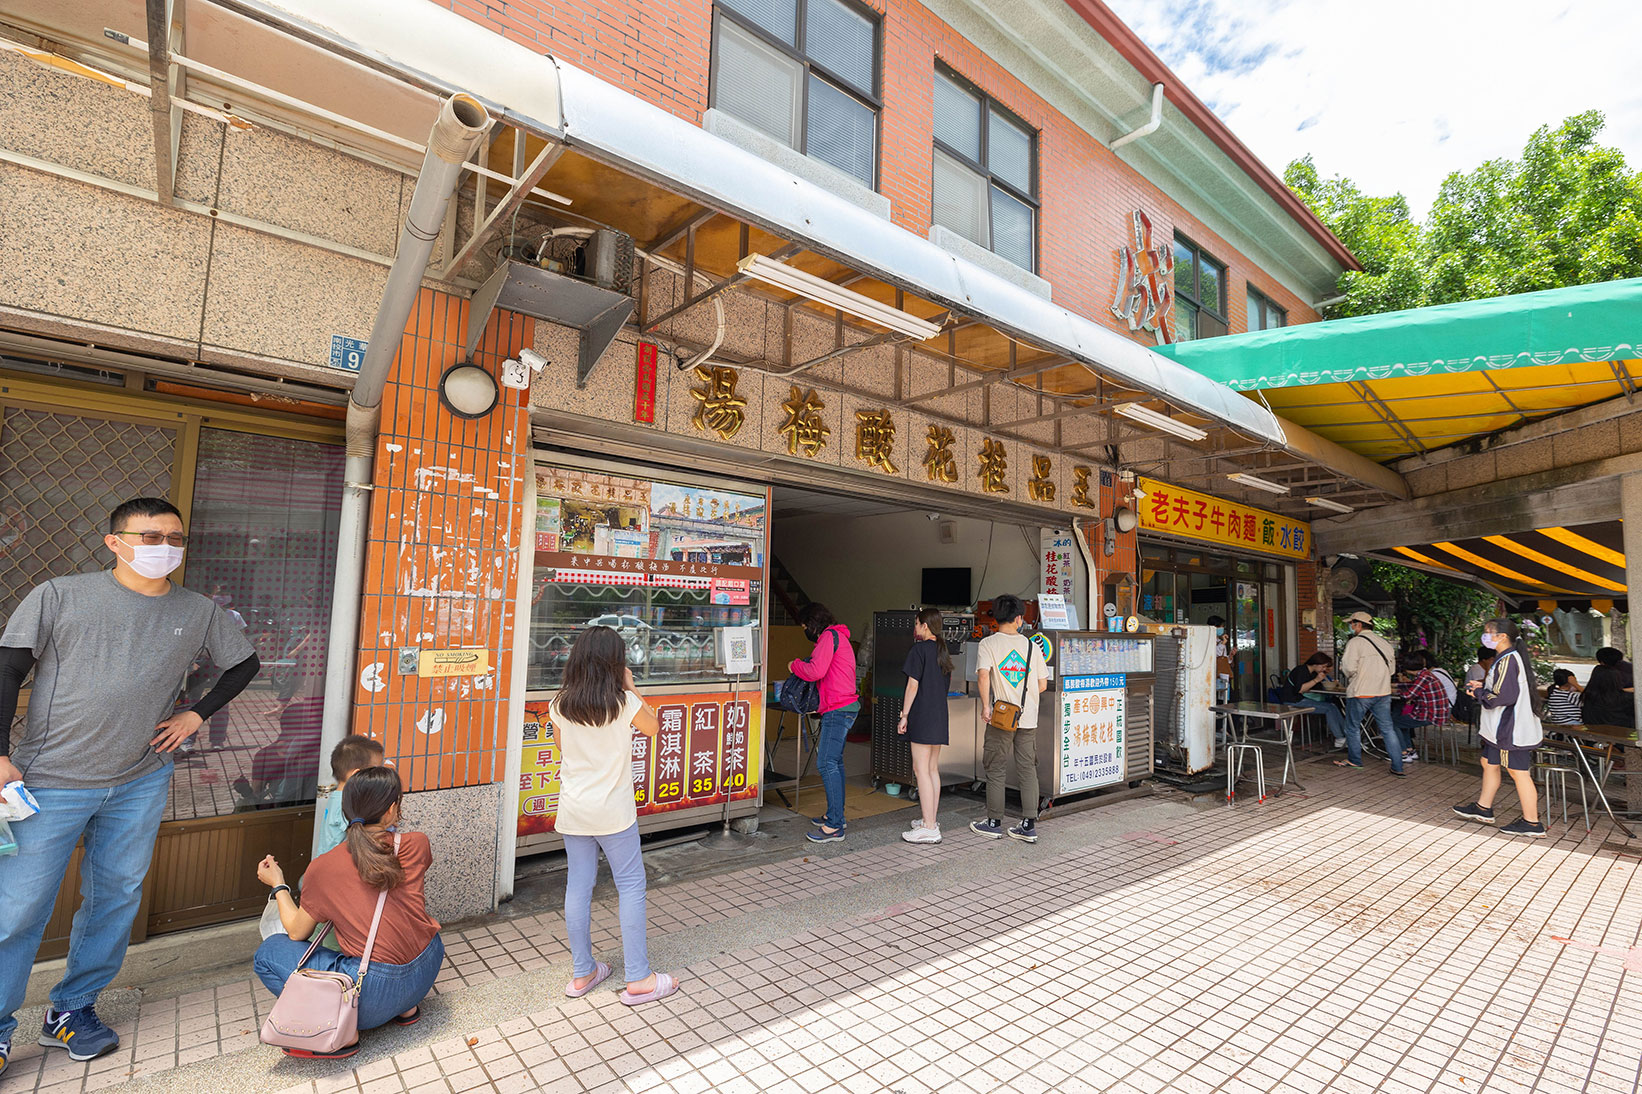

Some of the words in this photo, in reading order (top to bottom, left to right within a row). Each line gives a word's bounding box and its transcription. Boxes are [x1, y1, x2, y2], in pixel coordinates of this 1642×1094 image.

[348, 352, 359, 369] 9
[659, 708, 683, 780] 霜淇淋
[693, 707, 716, 775] 紅茶
[536, 750, 562, 767] 早
[692, 777, 713, 793] 35
[723, 773, 745, 787] 40
[658, 782, 680, 798] 25
